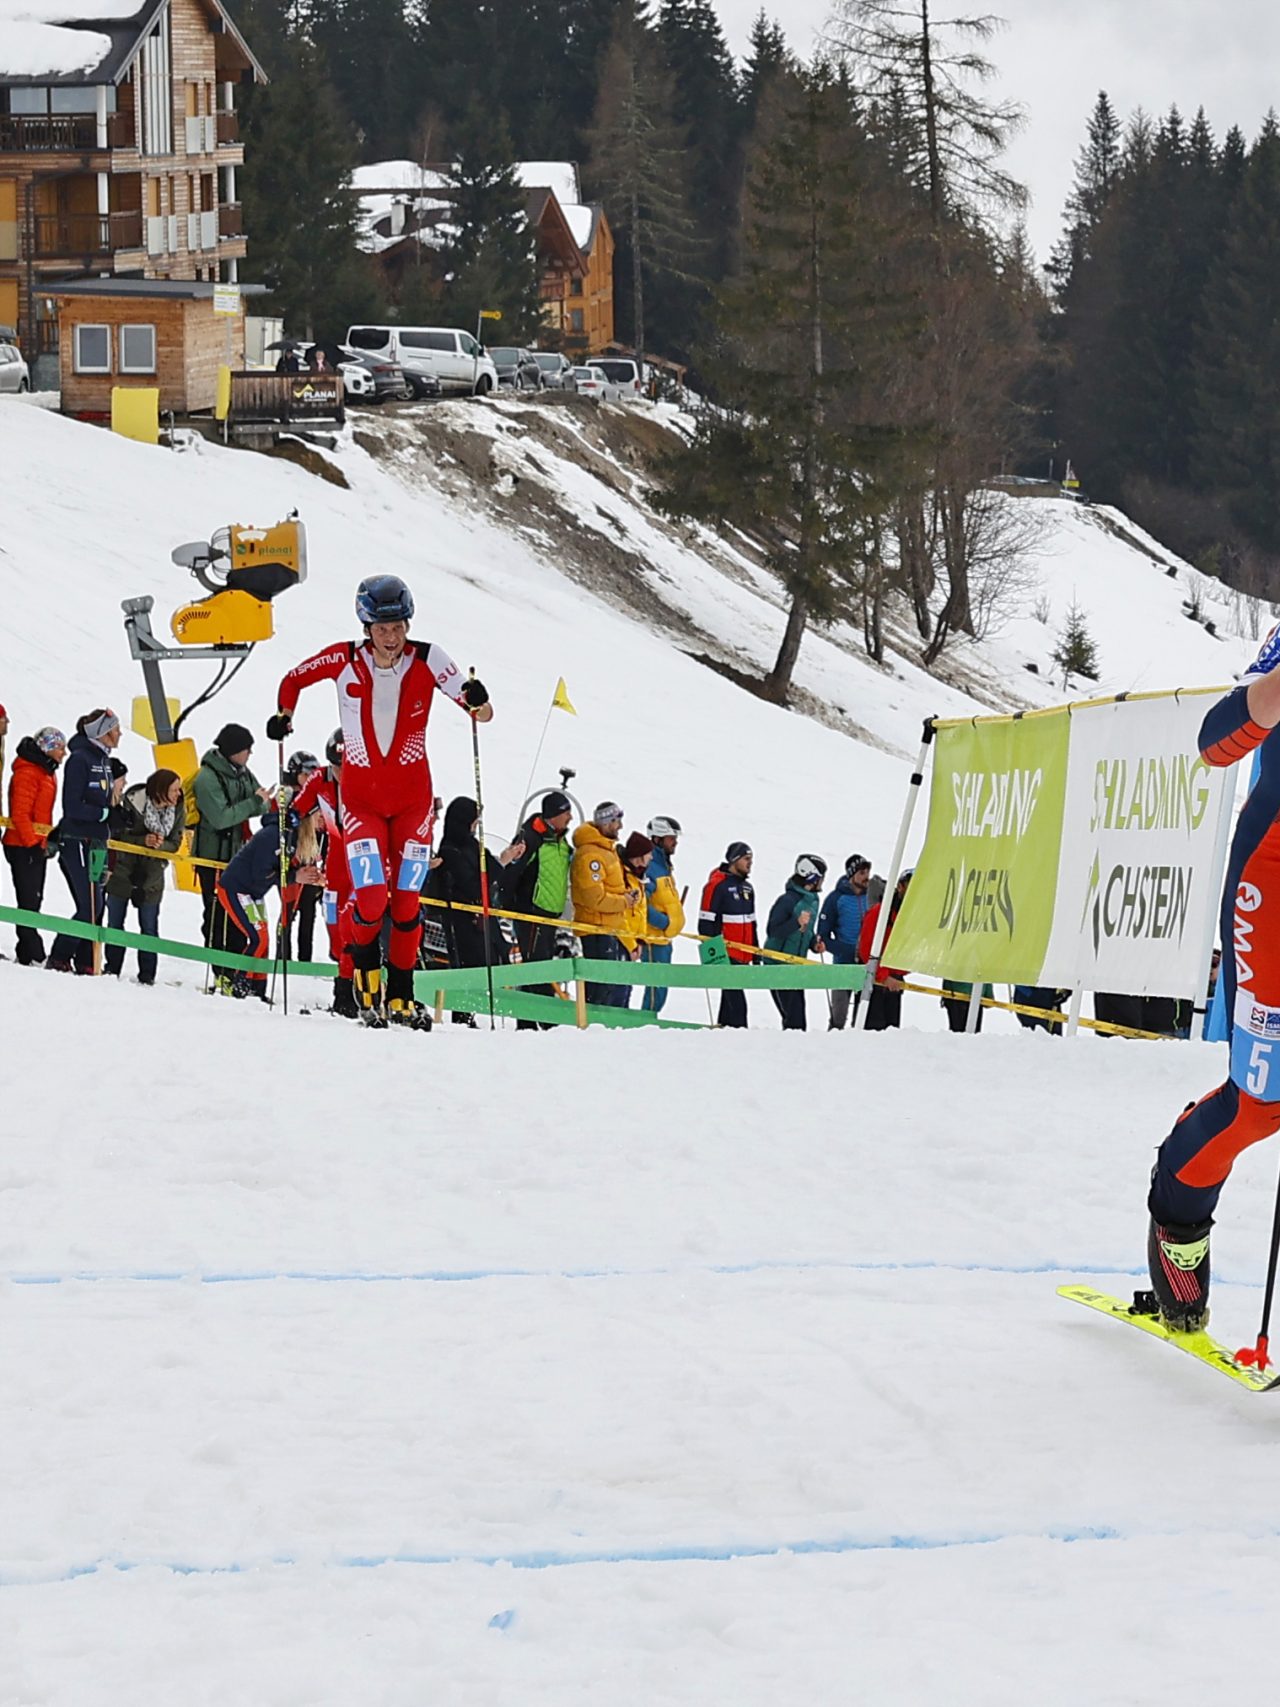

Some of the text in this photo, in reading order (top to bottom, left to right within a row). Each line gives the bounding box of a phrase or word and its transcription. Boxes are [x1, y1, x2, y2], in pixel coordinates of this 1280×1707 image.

[360, 856, 373, 885] 2
[408, 862, 422, 889] 2
[1246, 1041, 1272, 1095] 5
